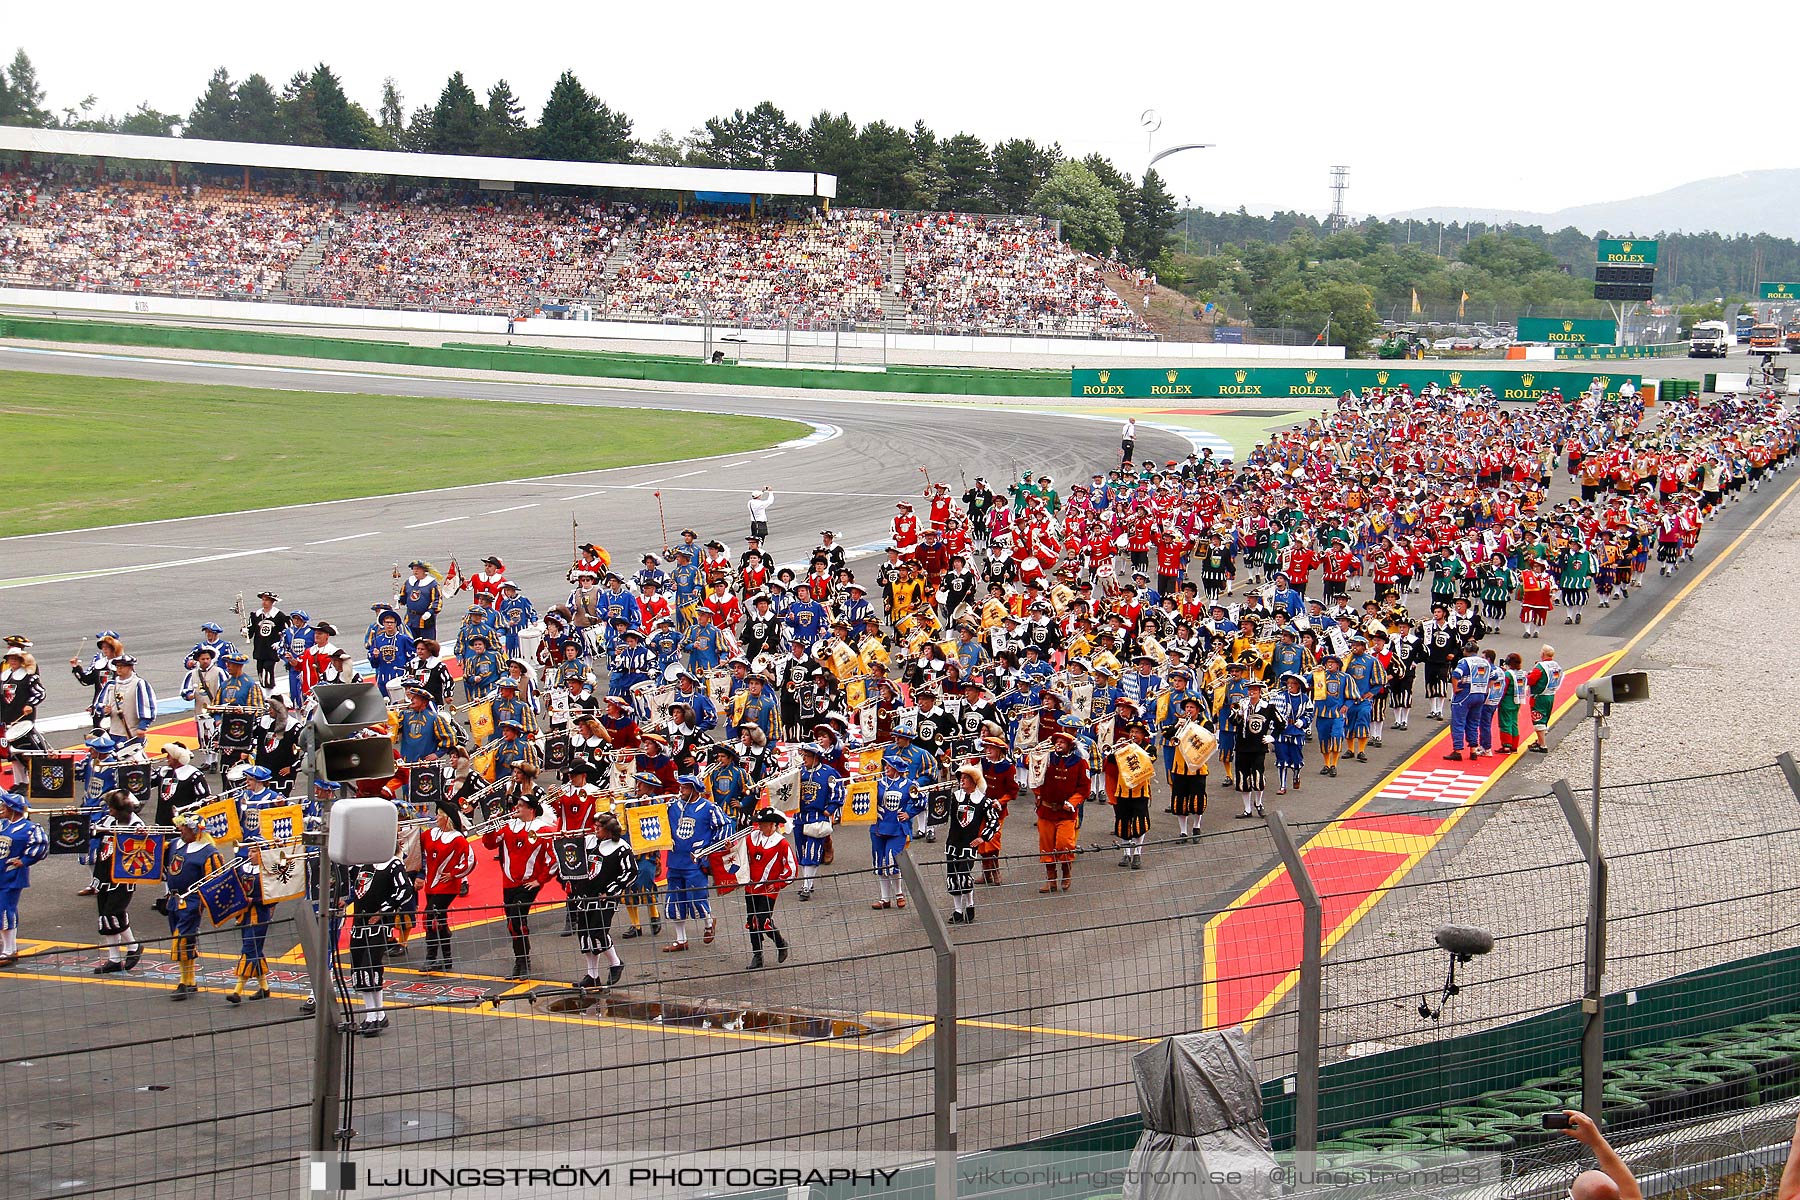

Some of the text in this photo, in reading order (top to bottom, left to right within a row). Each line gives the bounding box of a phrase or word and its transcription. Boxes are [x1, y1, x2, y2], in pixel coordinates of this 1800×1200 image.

[1608, 254, 1645, 263] ROLEX
[1548, 333, 1586, 342] ROLEX
[1083, 385, 1125, 395] ROLEX
[1151, 385, 1193, 395] ROLEX
[1219, 385, 1262, 395] ROLEX
[1289, 385, 1332, 395] ROLEX
